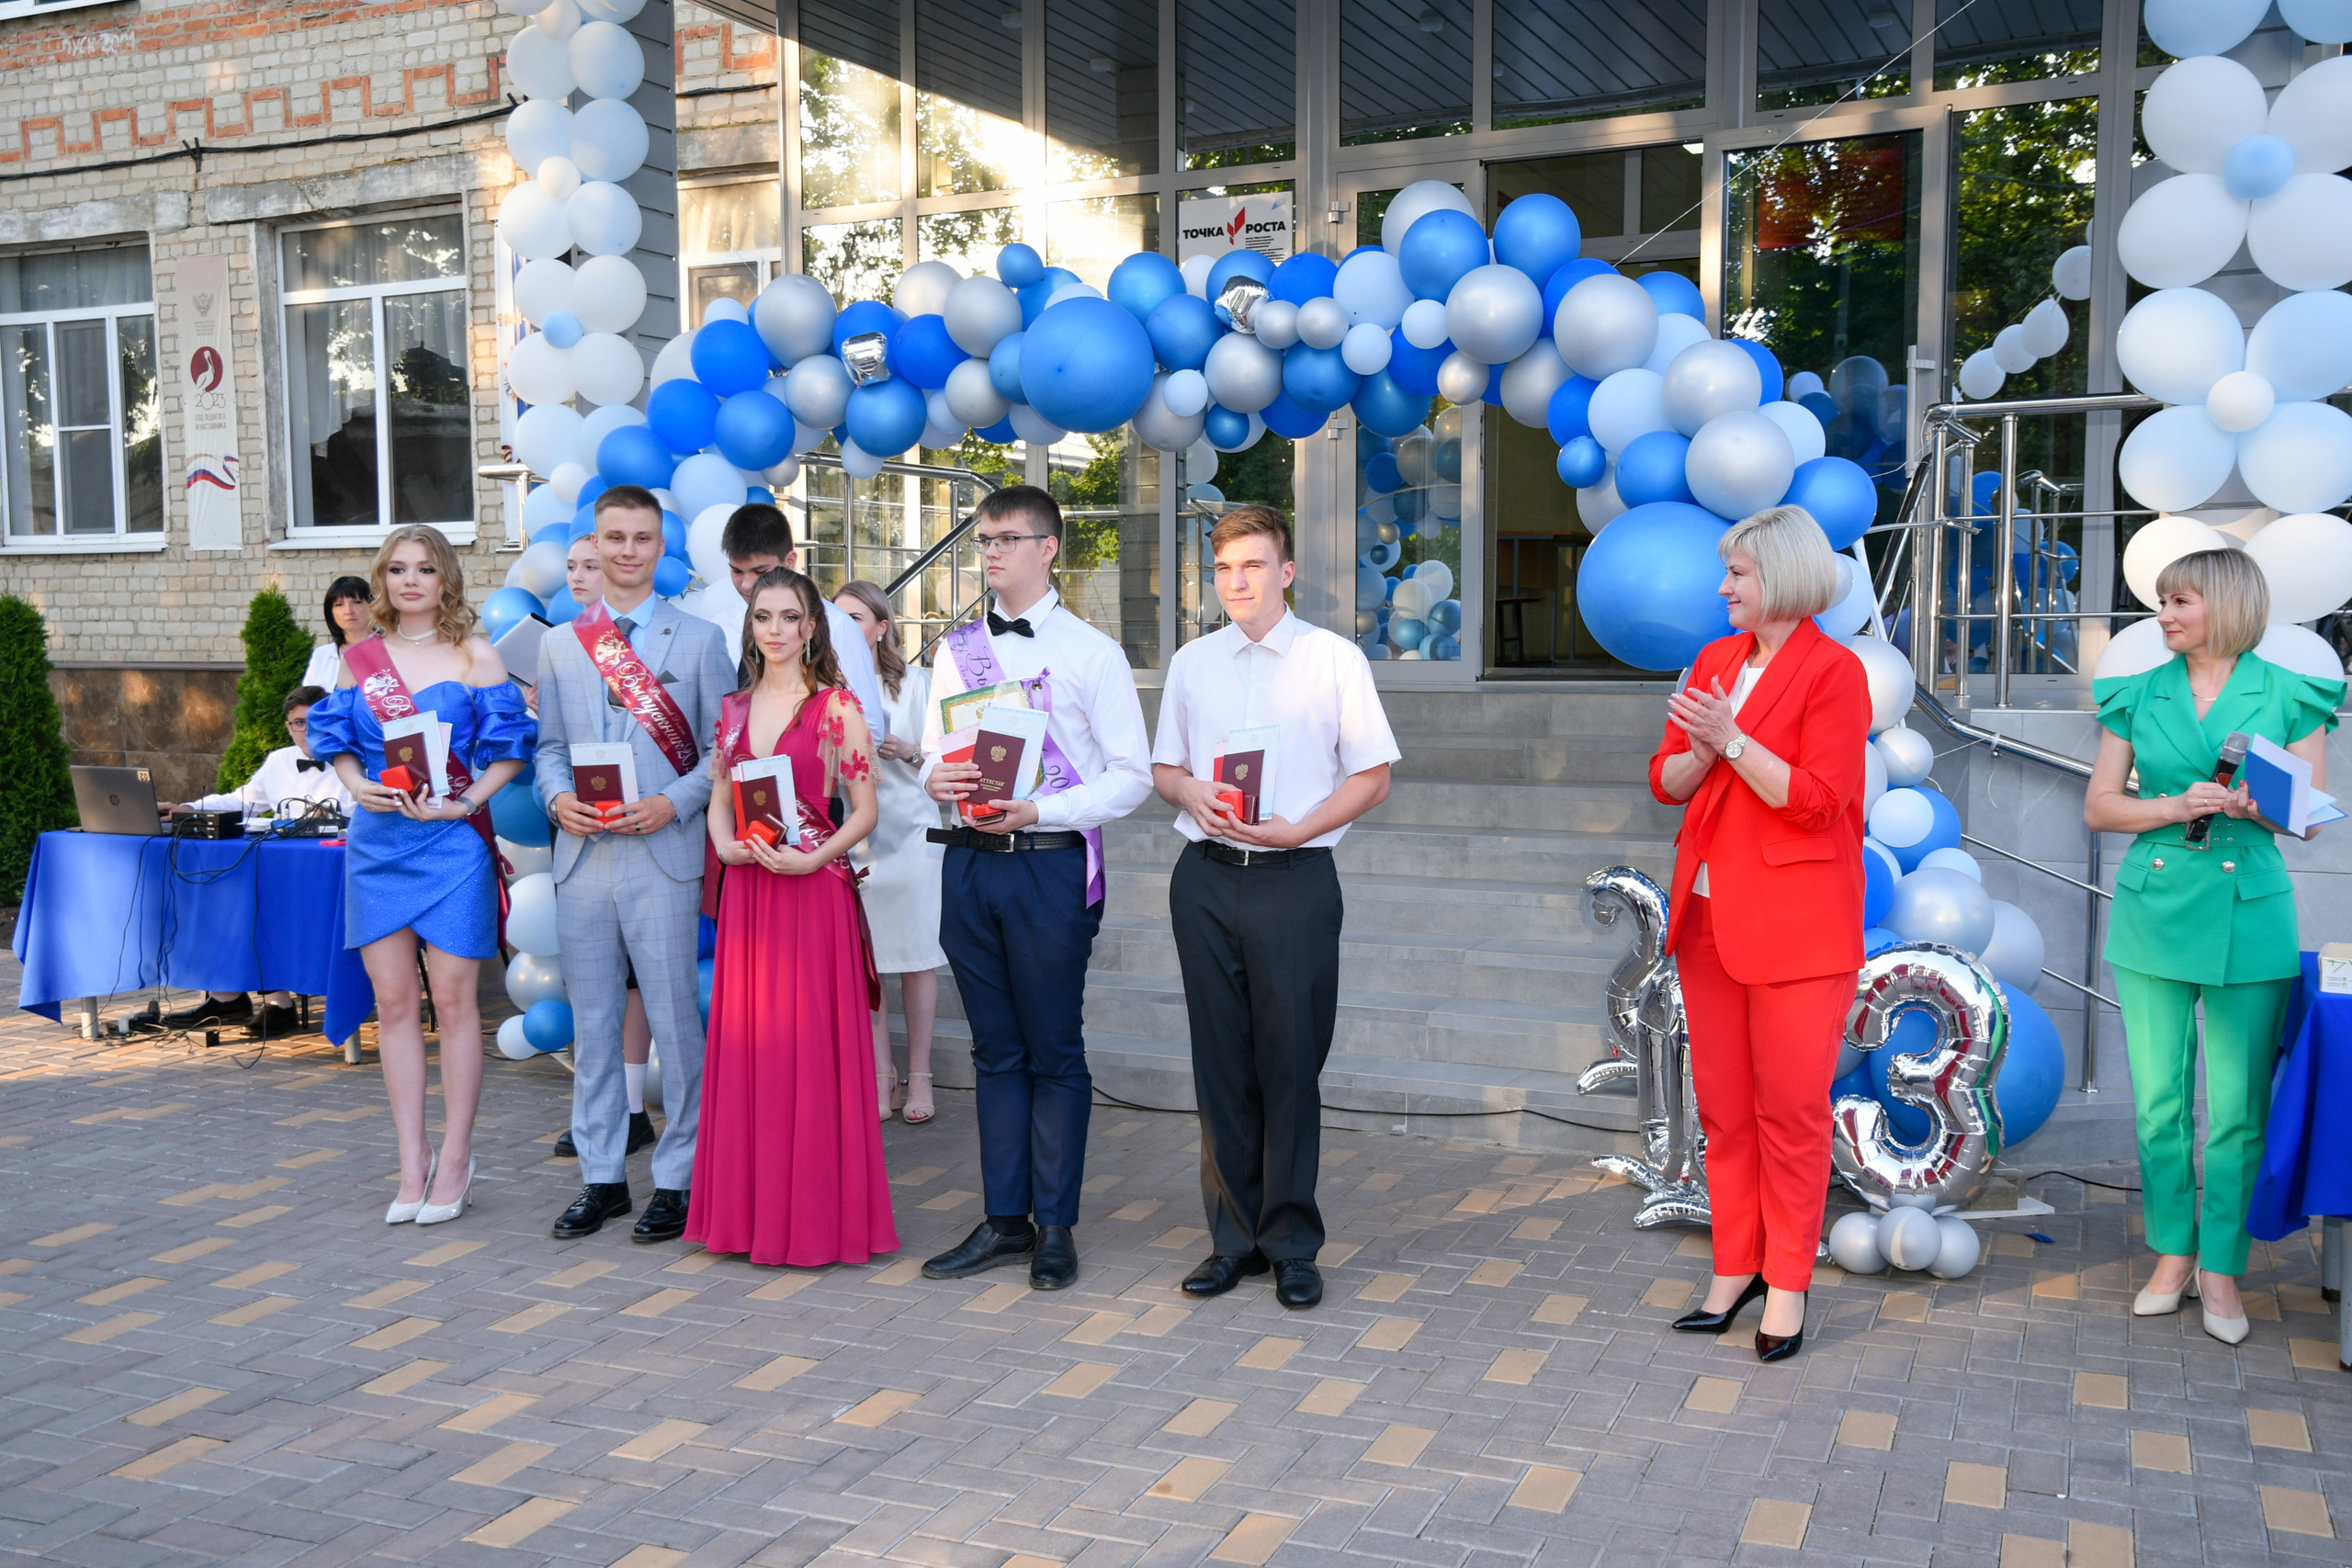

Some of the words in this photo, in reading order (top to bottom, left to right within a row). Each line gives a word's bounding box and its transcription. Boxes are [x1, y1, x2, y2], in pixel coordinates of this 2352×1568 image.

[1182, 226, 1225, 239] ТОЧКА
[1245, 220, 1286, 234] РОСТА
[195, 391, 226, 411] 2023
[195, 413, 204, 422] ГОД
[979, 777, 1005, 787] АТТЕСТАТ
